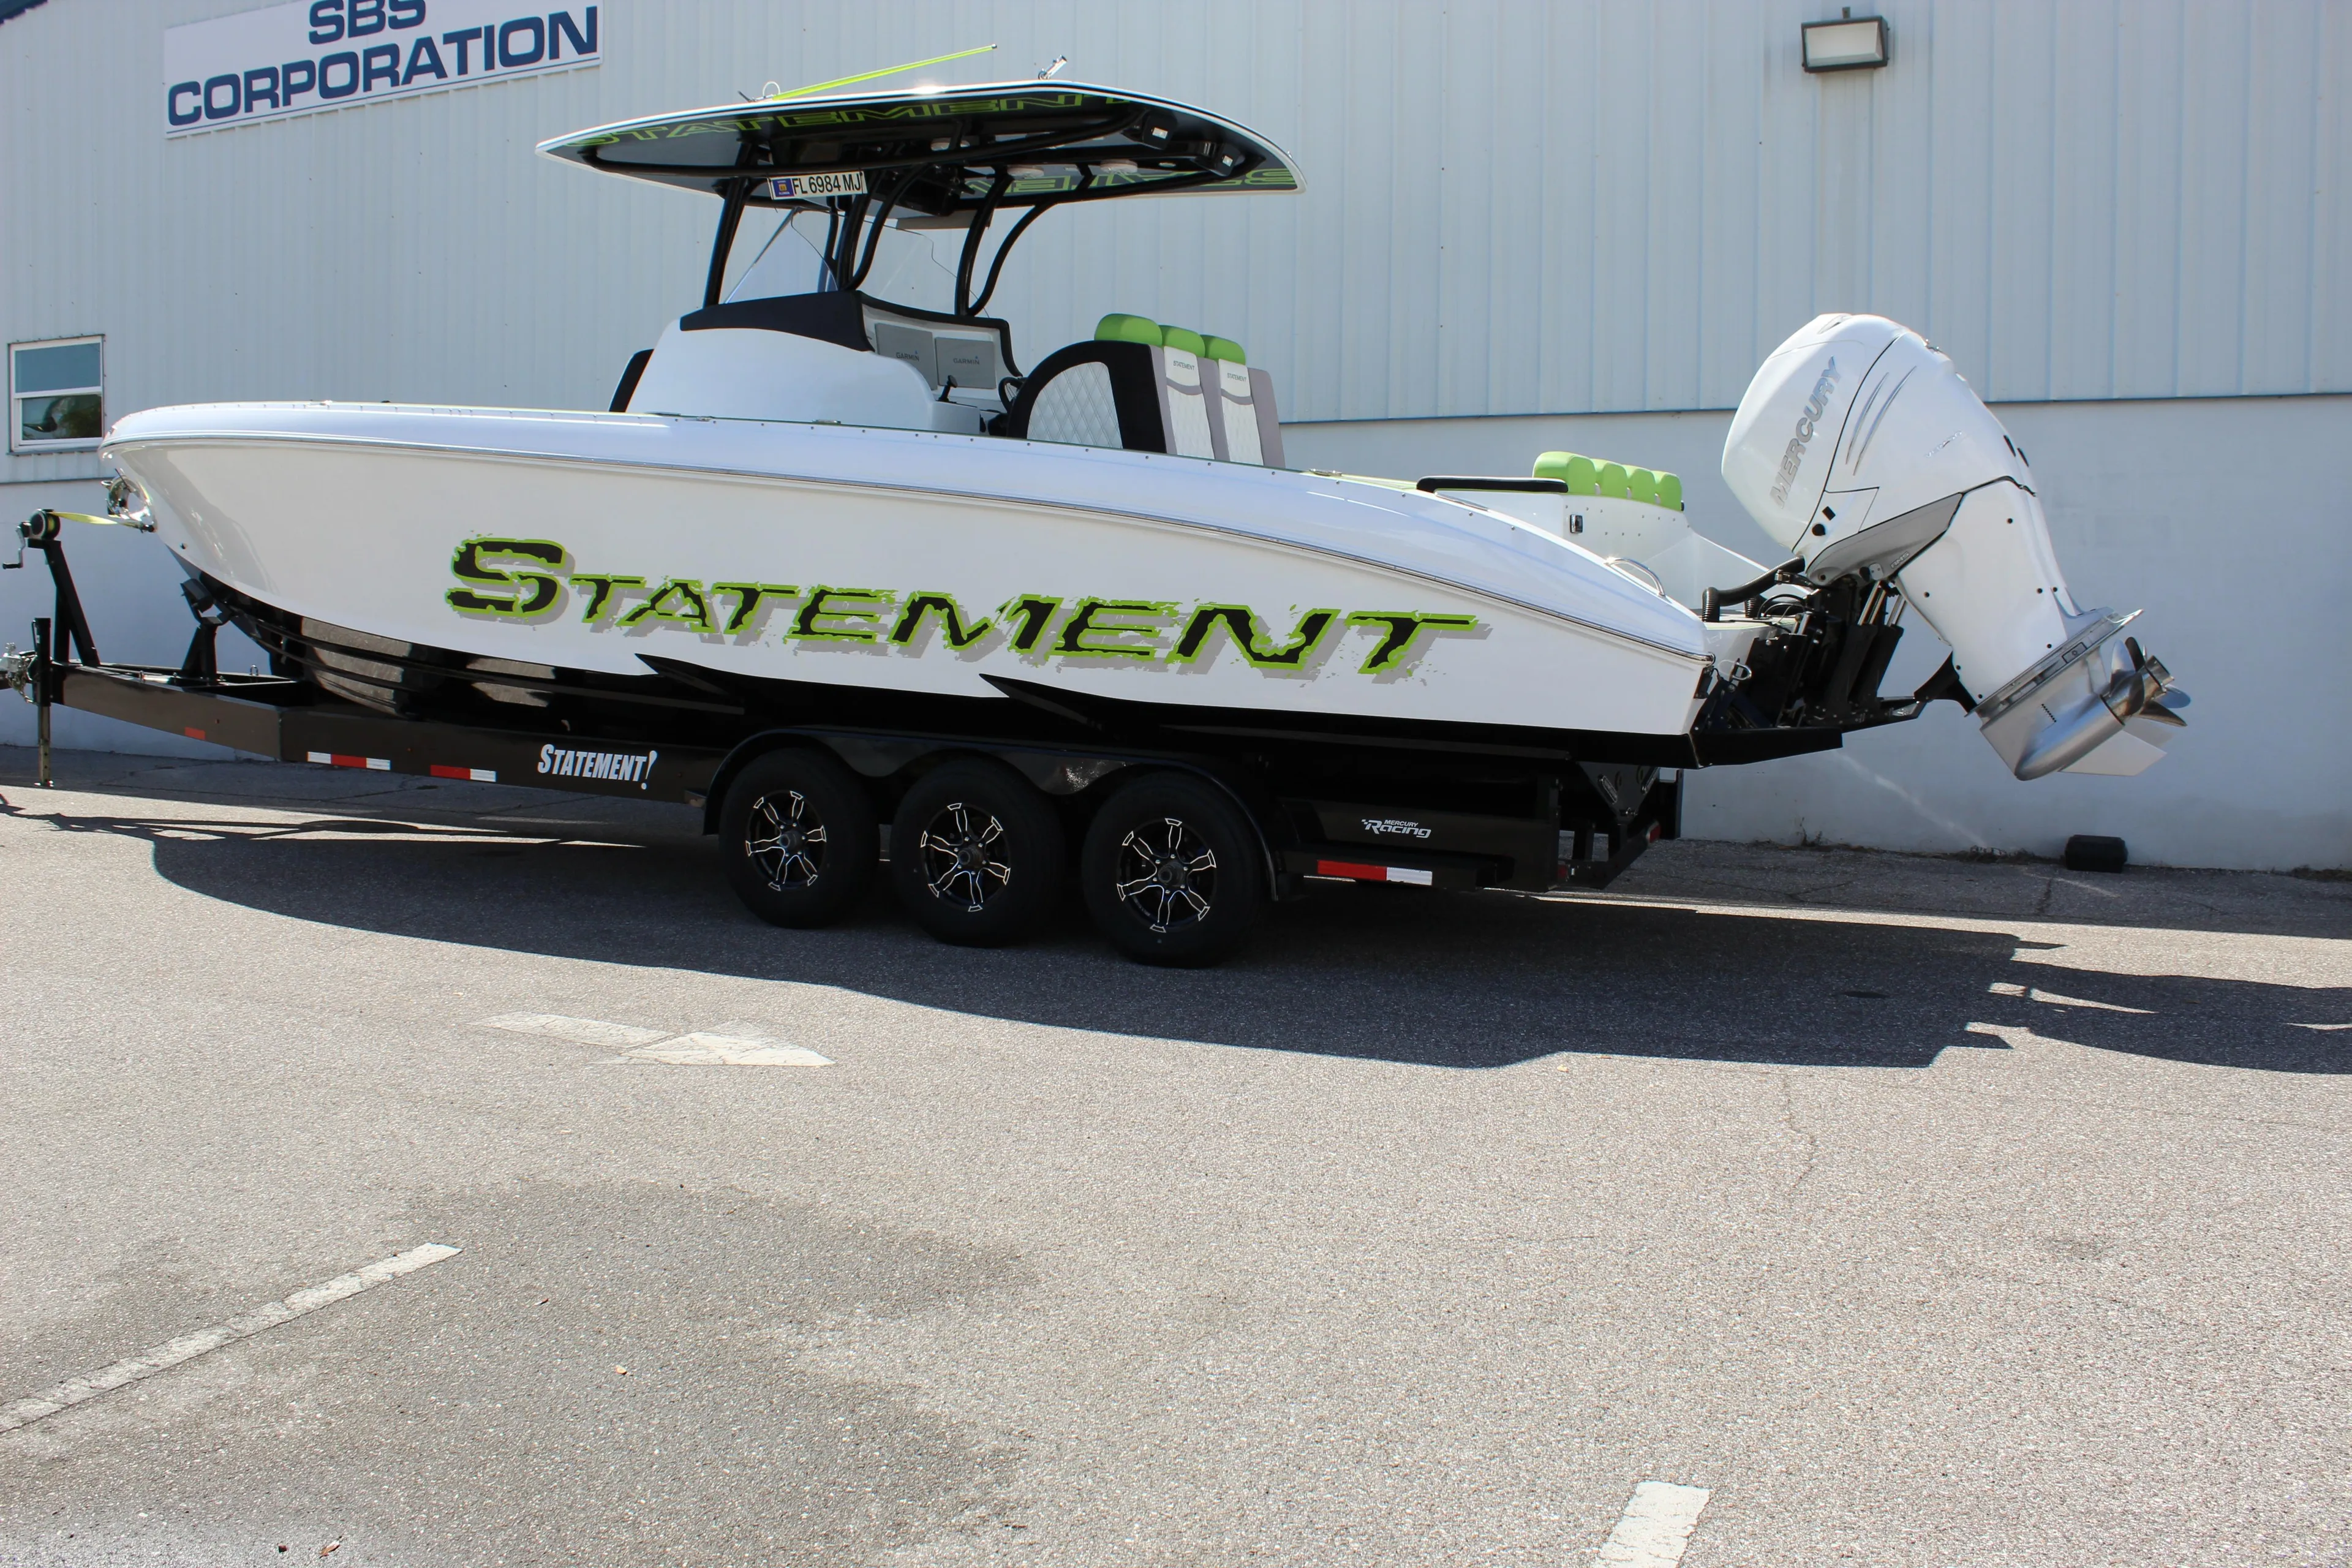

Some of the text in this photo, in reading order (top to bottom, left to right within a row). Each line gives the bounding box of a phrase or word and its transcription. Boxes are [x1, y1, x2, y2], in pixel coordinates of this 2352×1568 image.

[309, 0, 426, 45] SBS
[168, 6, 598, 126] CORPORATION
[565, 93, 1131, 147] STATEMEN
[792, 173, 861, 195] FL 6984 MJ
[895, 352, 919, 361] GARMIN
[1173, 360, 1195, 371] STATEMENT
[1227, 372, 1247, 382] STATEMENT
[1770, 355, 1841, 510] MERCURY
[445, 535, 1480, 677] STATEMENT
[537, 744, 658, 790] STATEMENT!
[1363, 820, 1432, 839] Racing
